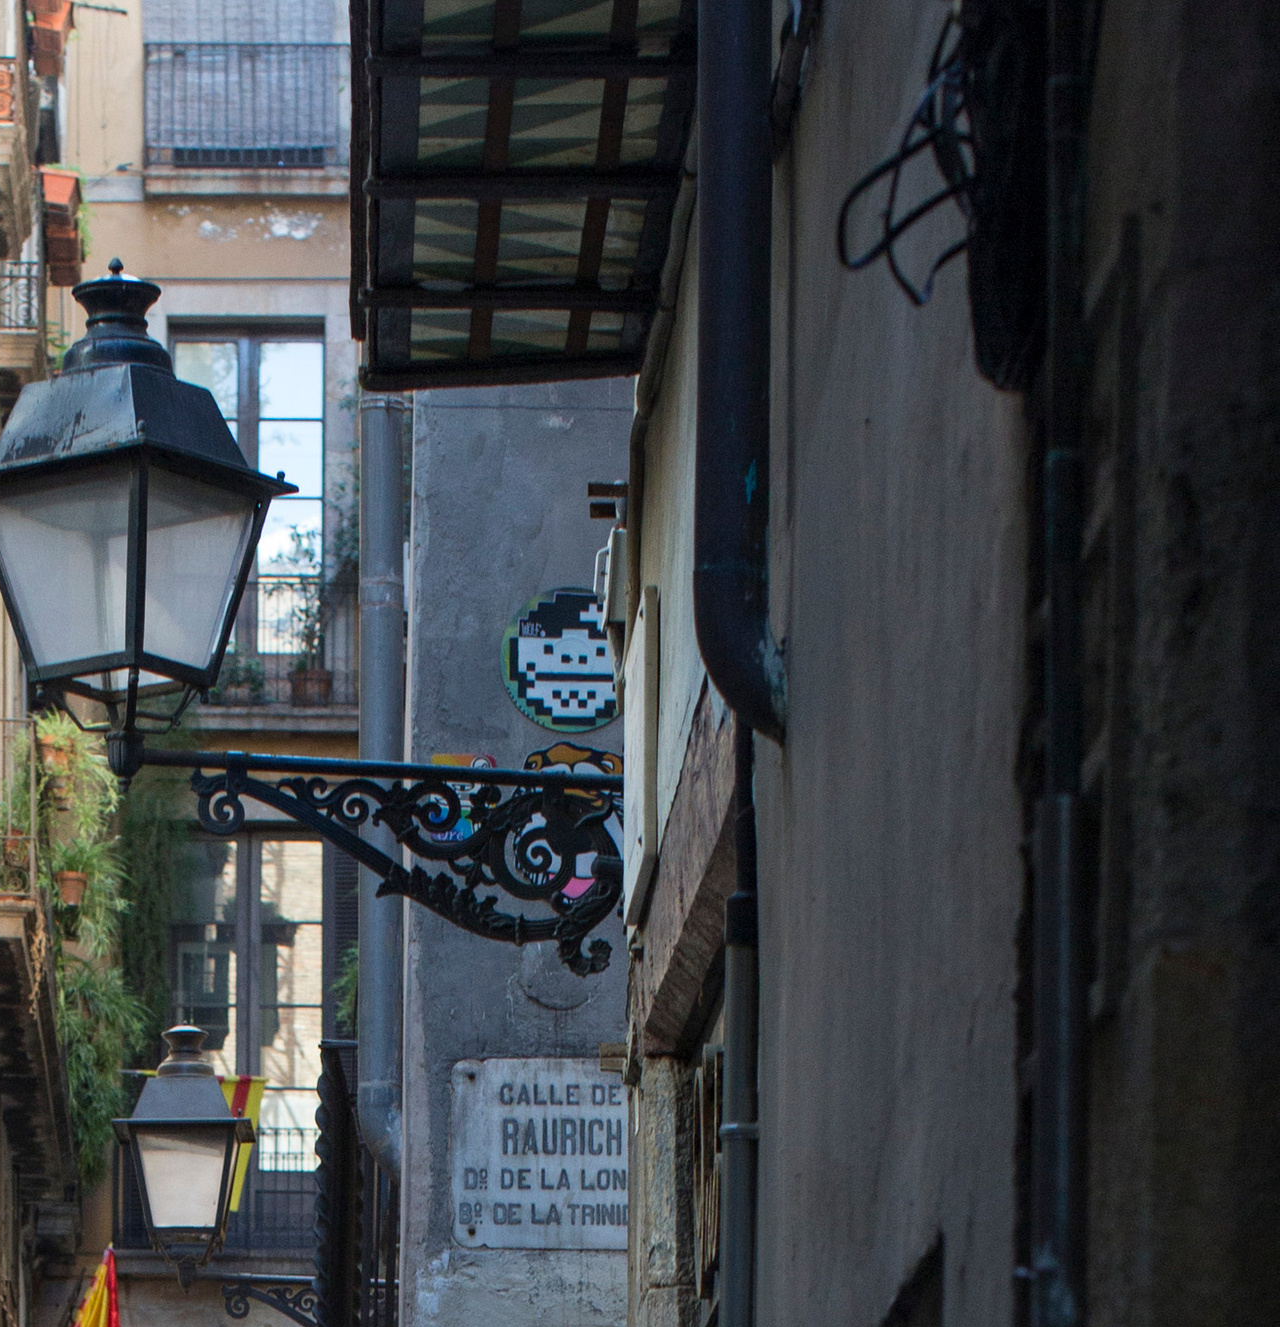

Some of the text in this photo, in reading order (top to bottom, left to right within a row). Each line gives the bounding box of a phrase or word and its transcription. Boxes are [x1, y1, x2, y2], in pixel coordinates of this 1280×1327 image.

[500, 1083, 622, 1106] CALLE DE
[502, 1118, 622, 1156] RAURICH
[500, 1168, 531, 1190] DE
[540, 1168, 570, 1190] LA
[493, 1203, 522, 1225] DE
[531, 1203, 561, 1225] LA
